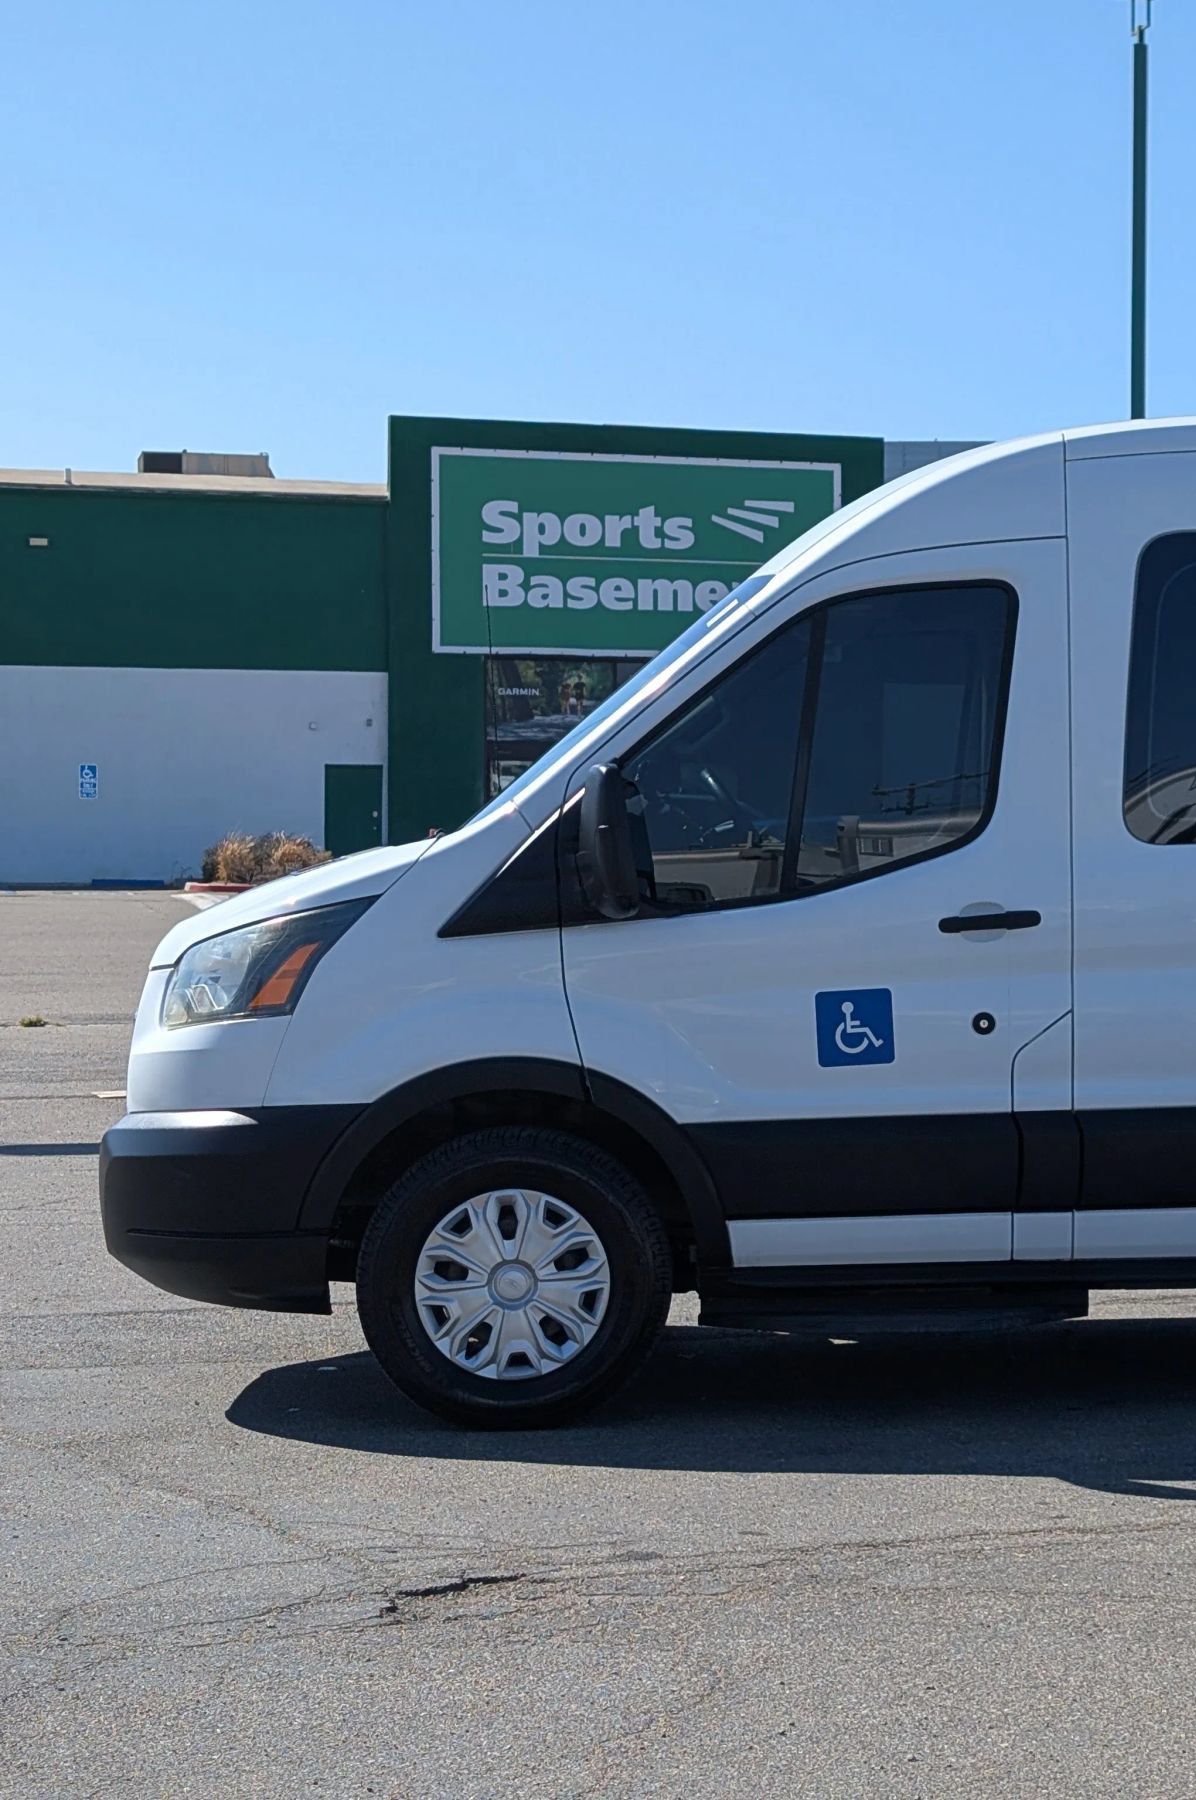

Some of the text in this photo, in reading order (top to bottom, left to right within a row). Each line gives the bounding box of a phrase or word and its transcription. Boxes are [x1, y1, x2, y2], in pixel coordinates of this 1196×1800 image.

[481, 500, 695, 556] Sports
[482, 563, 740, 612] Baseme
[497, 687, 540, 696] GARMIN
